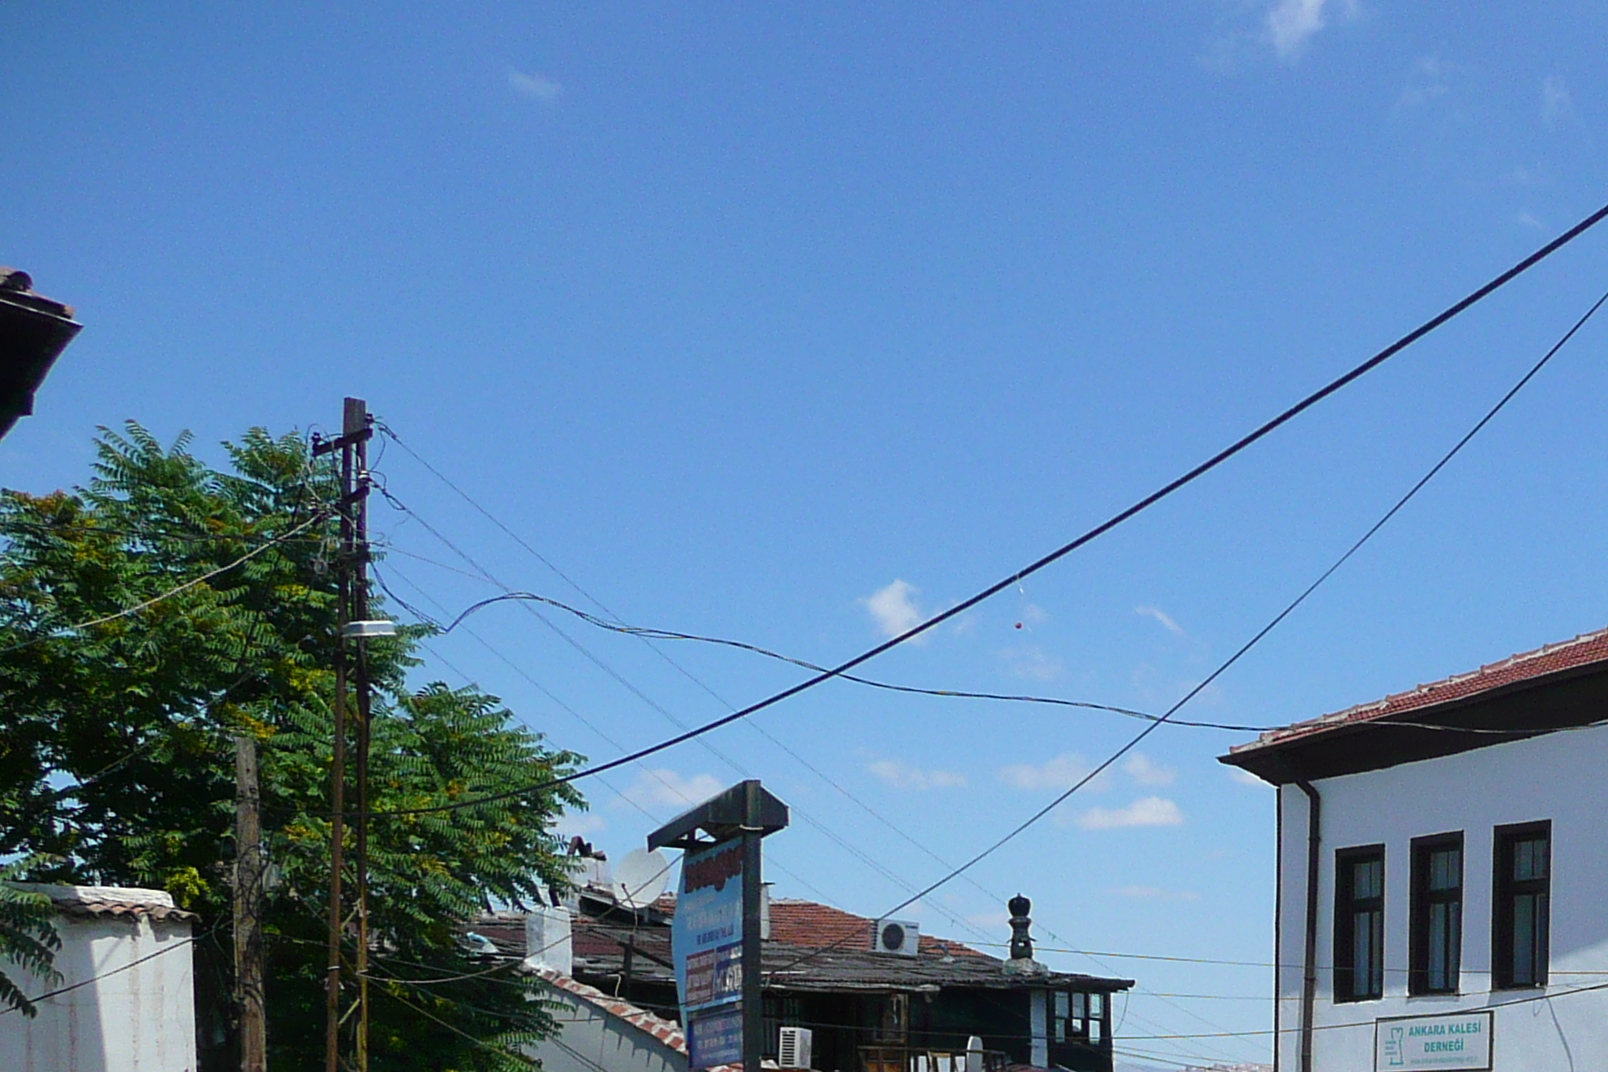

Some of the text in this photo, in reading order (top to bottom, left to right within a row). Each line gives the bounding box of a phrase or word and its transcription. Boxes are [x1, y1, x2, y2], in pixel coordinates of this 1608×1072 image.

[1408, 1020, 1482, 1037] ANKARA KALESİ
[1424, 1038, 1464, 1053] DERNEĞİ
